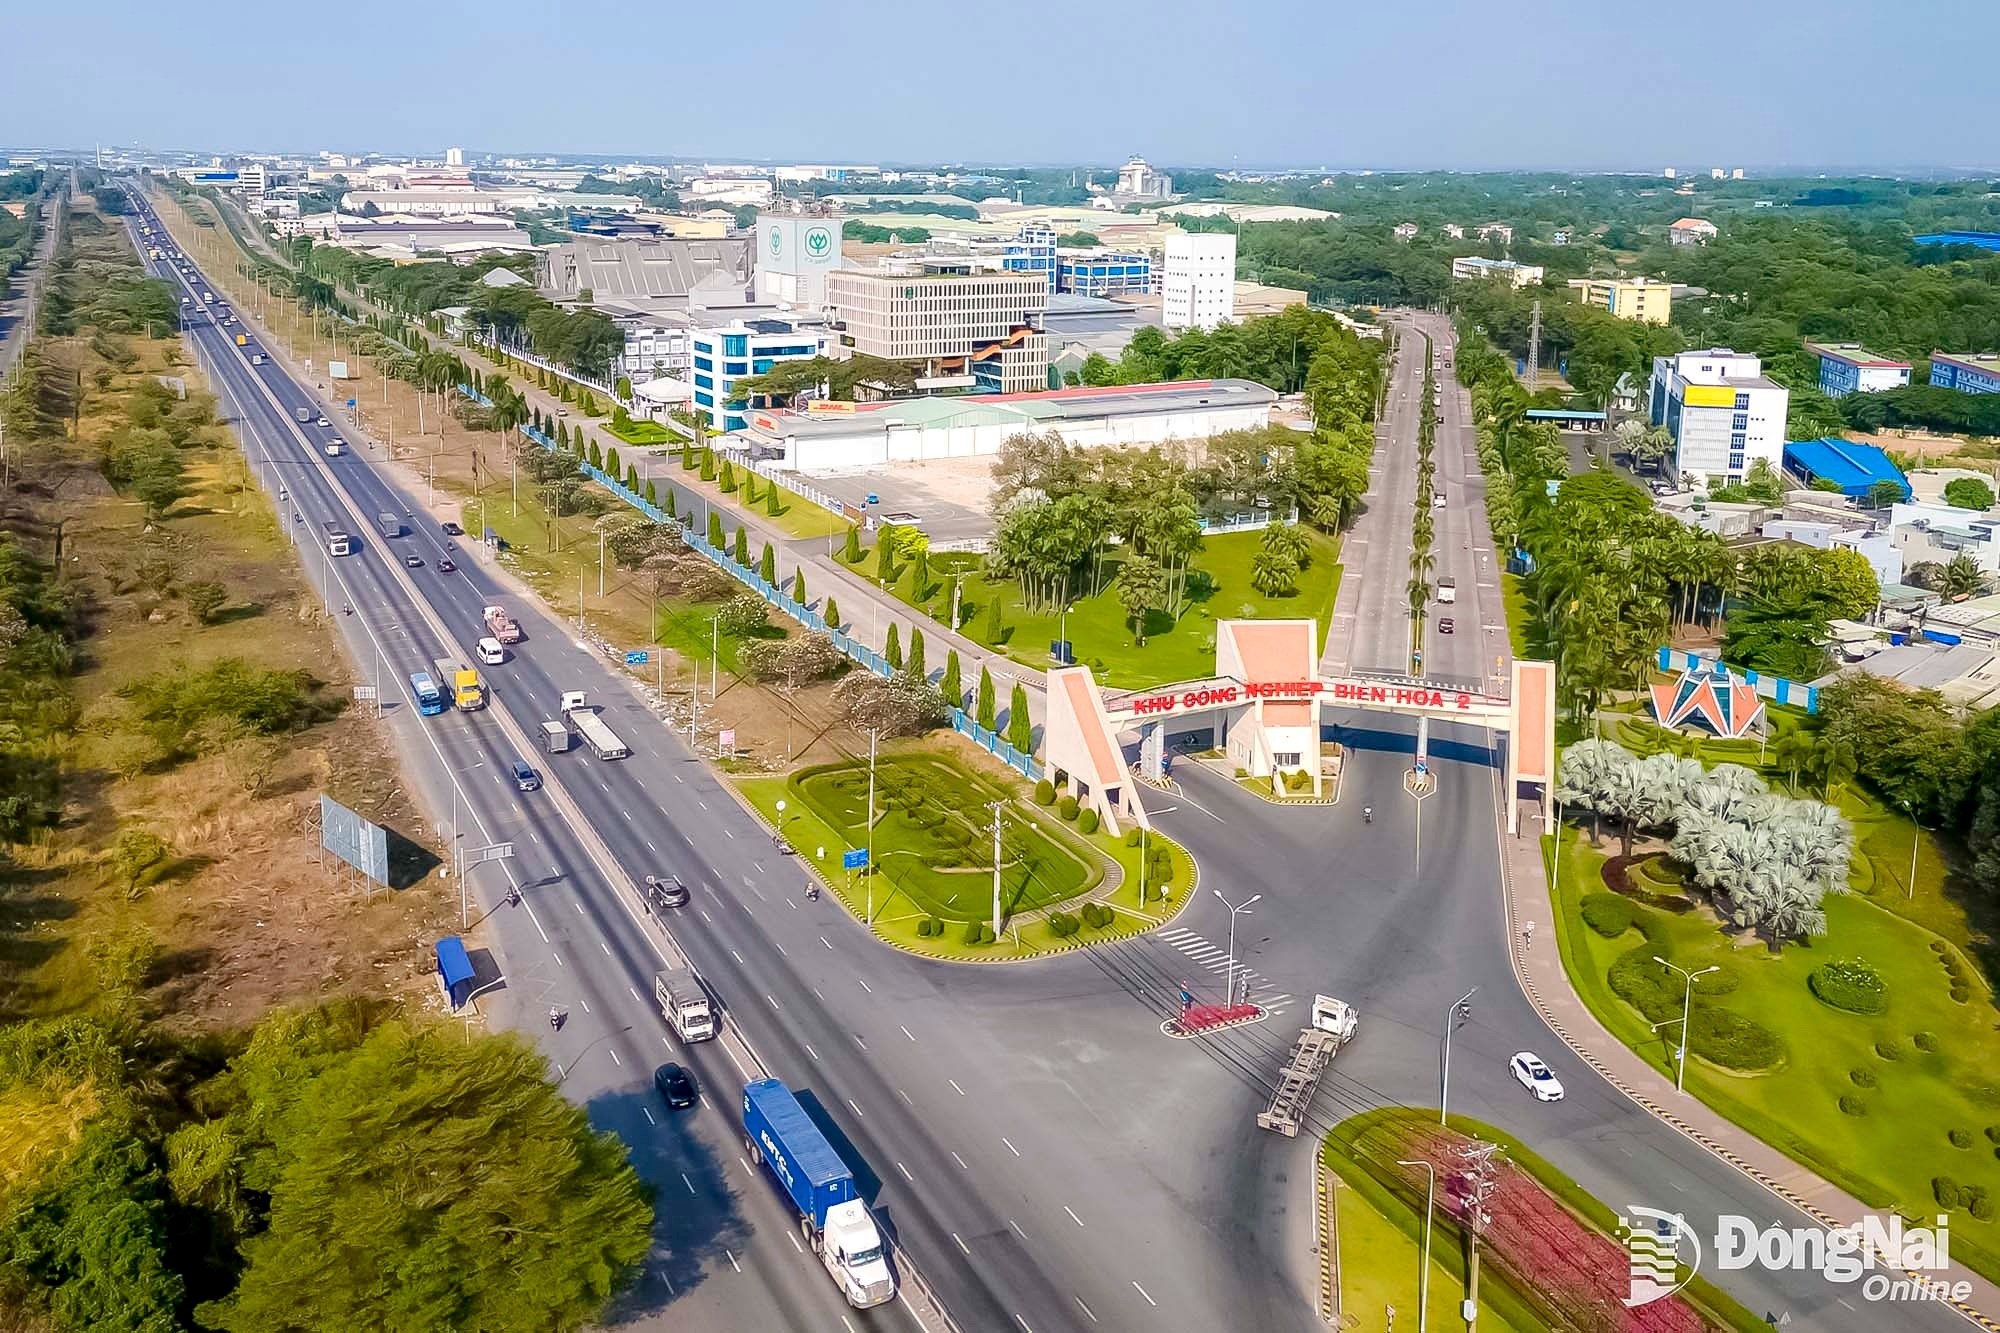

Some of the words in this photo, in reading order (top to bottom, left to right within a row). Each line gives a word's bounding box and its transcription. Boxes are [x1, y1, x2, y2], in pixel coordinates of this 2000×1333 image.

[1133, 695, 1175, 715] KHU
[1183, 685, 1237, 708] CÔNG
[1335, 680, 1386, 702] BIÊN
[1457, 693, 1471, 709] 2
